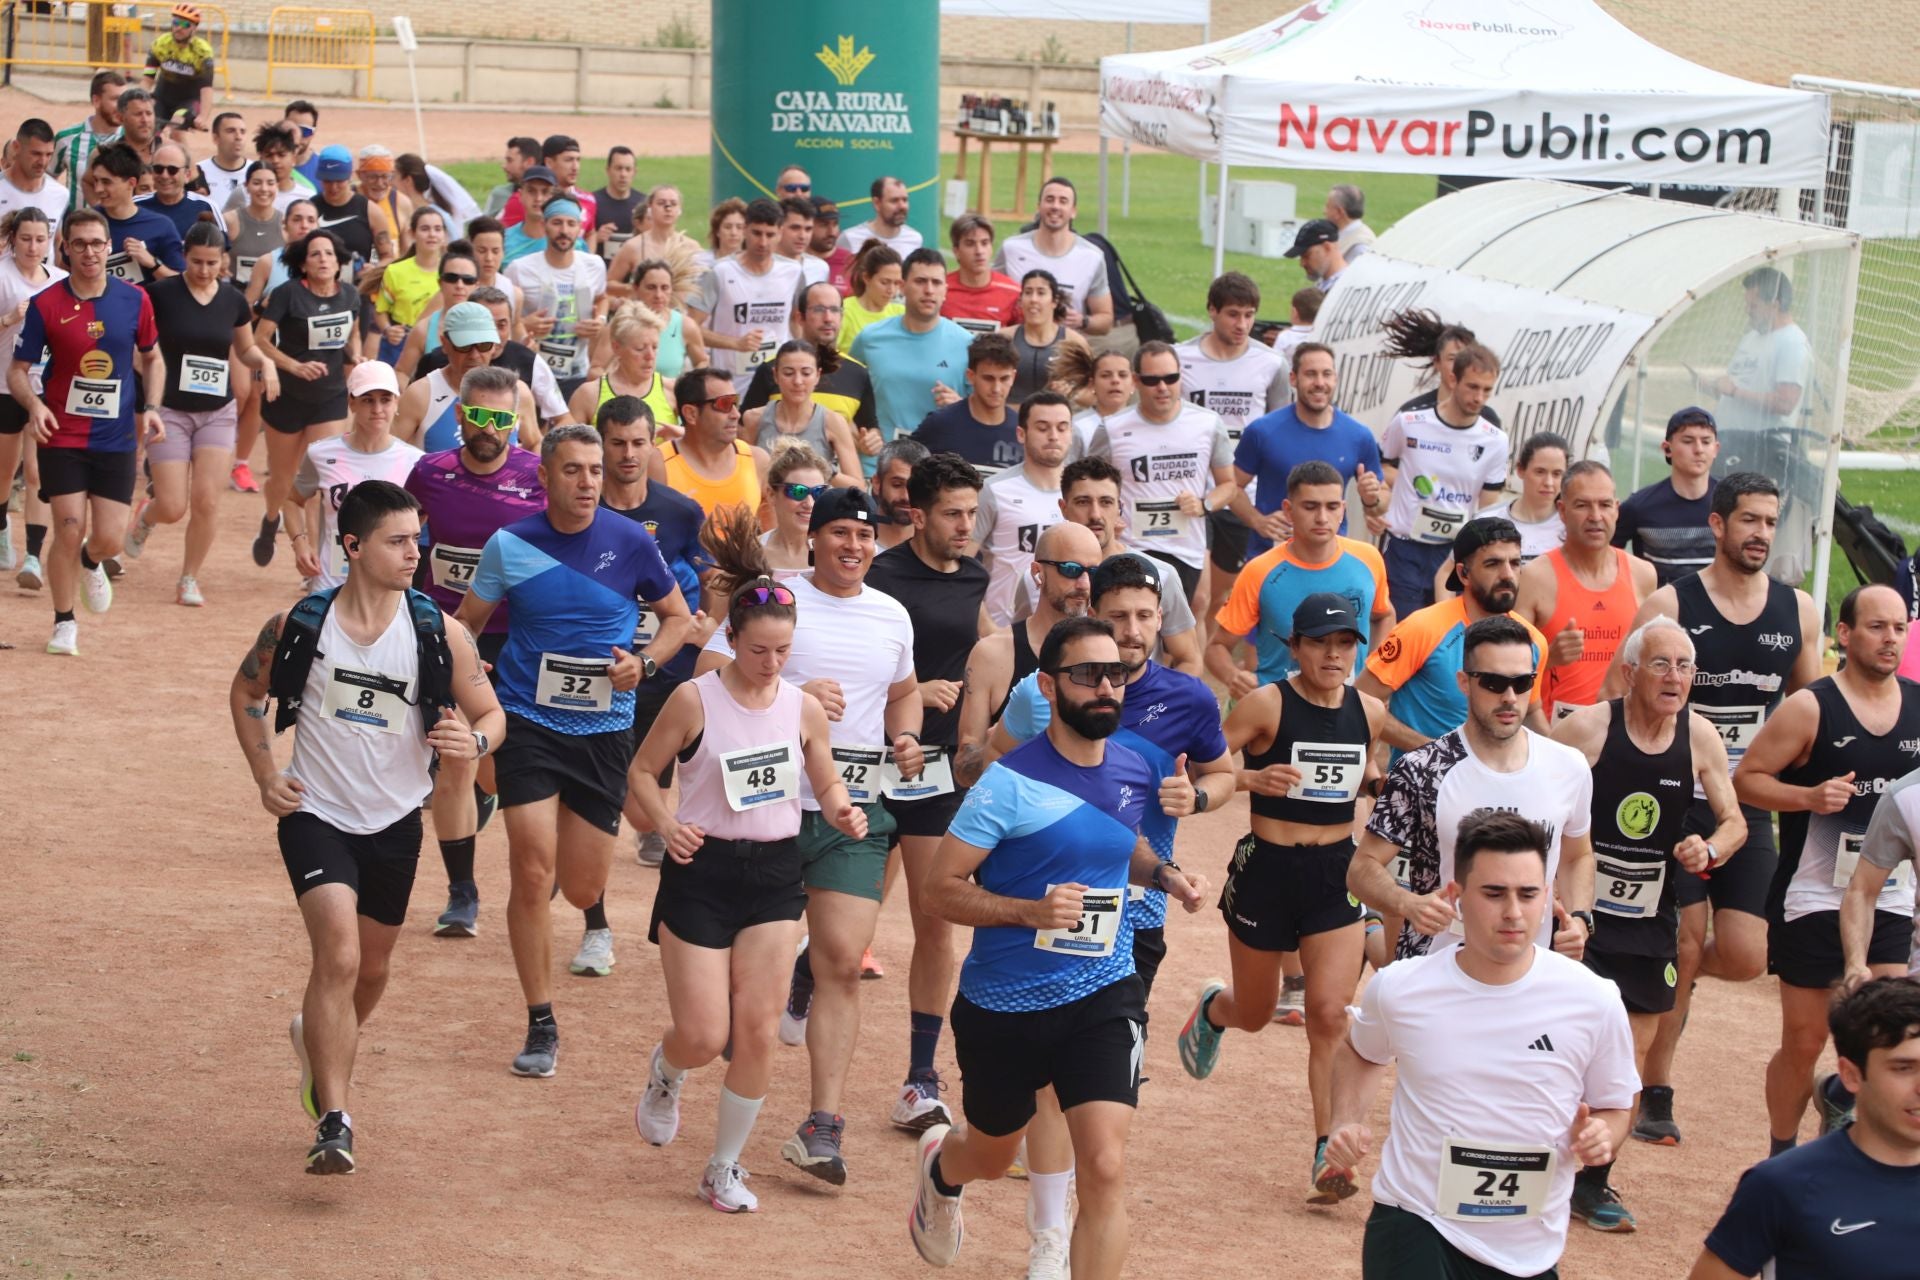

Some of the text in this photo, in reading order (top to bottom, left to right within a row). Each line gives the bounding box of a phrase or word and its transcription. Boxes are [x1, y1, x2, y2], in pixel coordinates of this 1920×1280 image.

[1419, 18, 1558, 36] NavarPubli.com
[775, 91, 908, 113] CAJA RURAL
[771, 113, 913, 134] DE NAVARRA
[1277, 102, 1772, 165] NavarPubli.com
[795, 138, 895, 150] ACCIÓN SOCIAL
[326, 326, 342, 338] 18
[547, 356, 566, 368] 63
[751, 352, 766, 364] 61
[191, 369, 220, 384] 505
[83, 392, 105, 406] 66
[1208, 398, 1243, 406] CIUDAD
[1152, 462, 1188, 471] CIUDAD
[1153, 470, 1197, 482] ALFARO
[1148, 512, 1171, 526] 73
[1431, 520, 1451, 534] 90
[449, 564, 475, 580] 47
[561, 676, 592, 694] 32
[357, 690, 375, 708] 8
[360, 709, 382, 718] CARLOS
[747, 766, 776, 788] 48
[842, 764, 868, 784] 42
[1314, 765, 1344, 784] 55
[1609, 880, 1643, 901] 87
[1466, 1152, 1487, 1160] CROSS
[1473, 1170, 1520, 1197] 24
[1478, 1198, 1512, 1206] ÁLVARO
